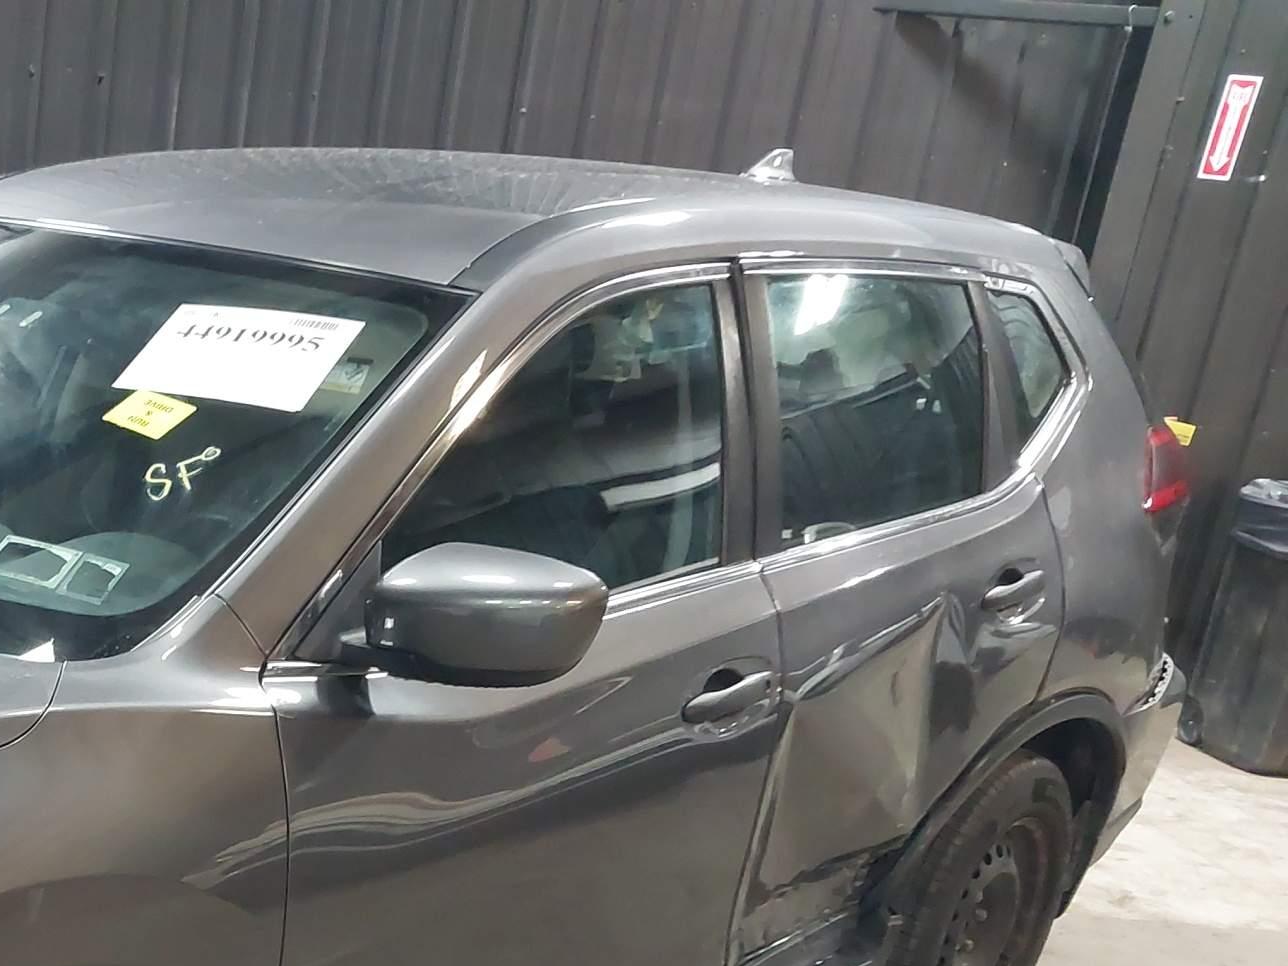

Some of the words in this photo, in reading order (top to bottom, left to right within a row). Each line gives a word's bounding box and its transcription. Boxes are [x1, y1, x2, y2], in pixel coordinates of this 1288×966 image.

[176, 323, 326, 352] 44919995
[143, 399, 175, 414] DRIVE
[127, 415, 150, 428] RUN
